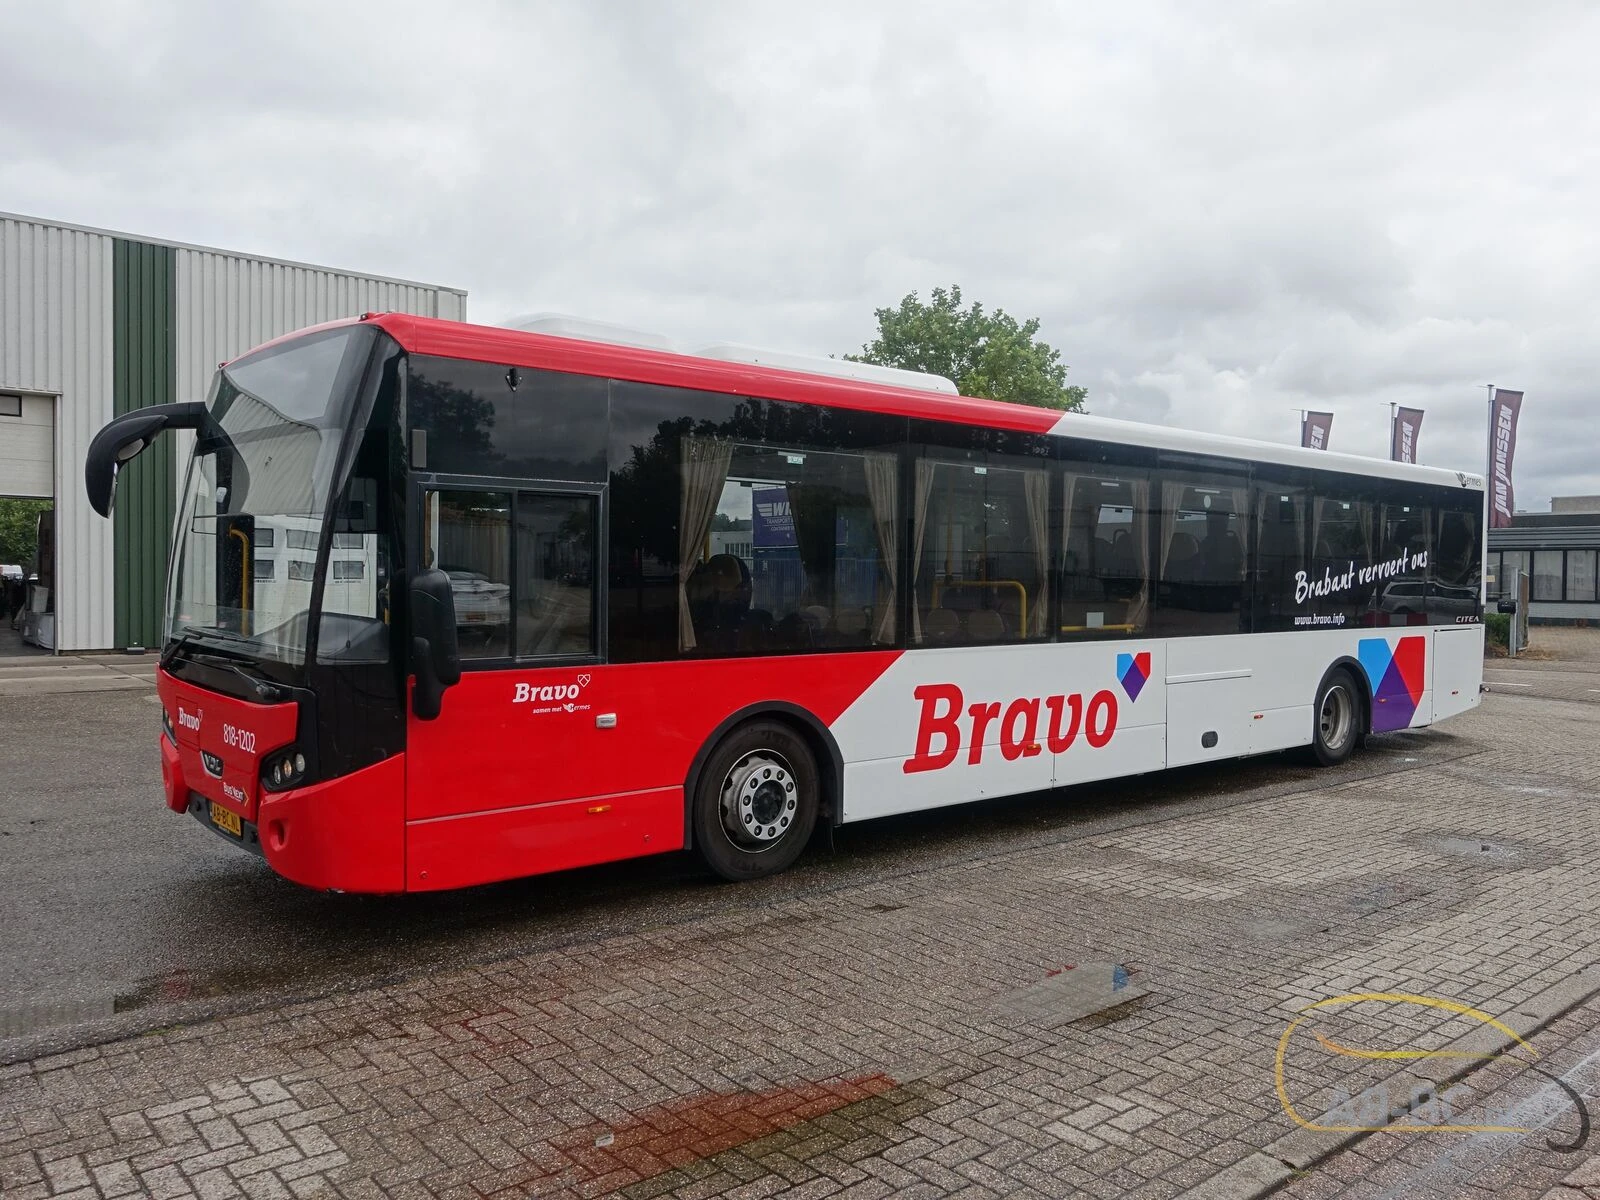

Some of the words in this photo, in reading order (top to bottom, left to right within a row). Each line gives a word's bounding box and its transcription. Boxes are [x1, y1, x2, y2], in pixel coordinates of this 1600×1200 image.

[1495, 404, 1513, 486] JANSSEN
[1494, 481, 1512, 518] JAN
[1294, 561, 1355, 605] Brabant
[1358, 546, 1409, 585] vervoert
[1411, 550, 1428, 570] ons
[1294, 613, 1346, 626] www.bravo.info
[1455, 615, 1480, 623] CITEA
[512, 682, 580, 703] Bravo
[178, 706, 201, 732] Bravo
[902, 682, 1118, 774] Bravo
[223, 723, 256, 754] 818-1202
